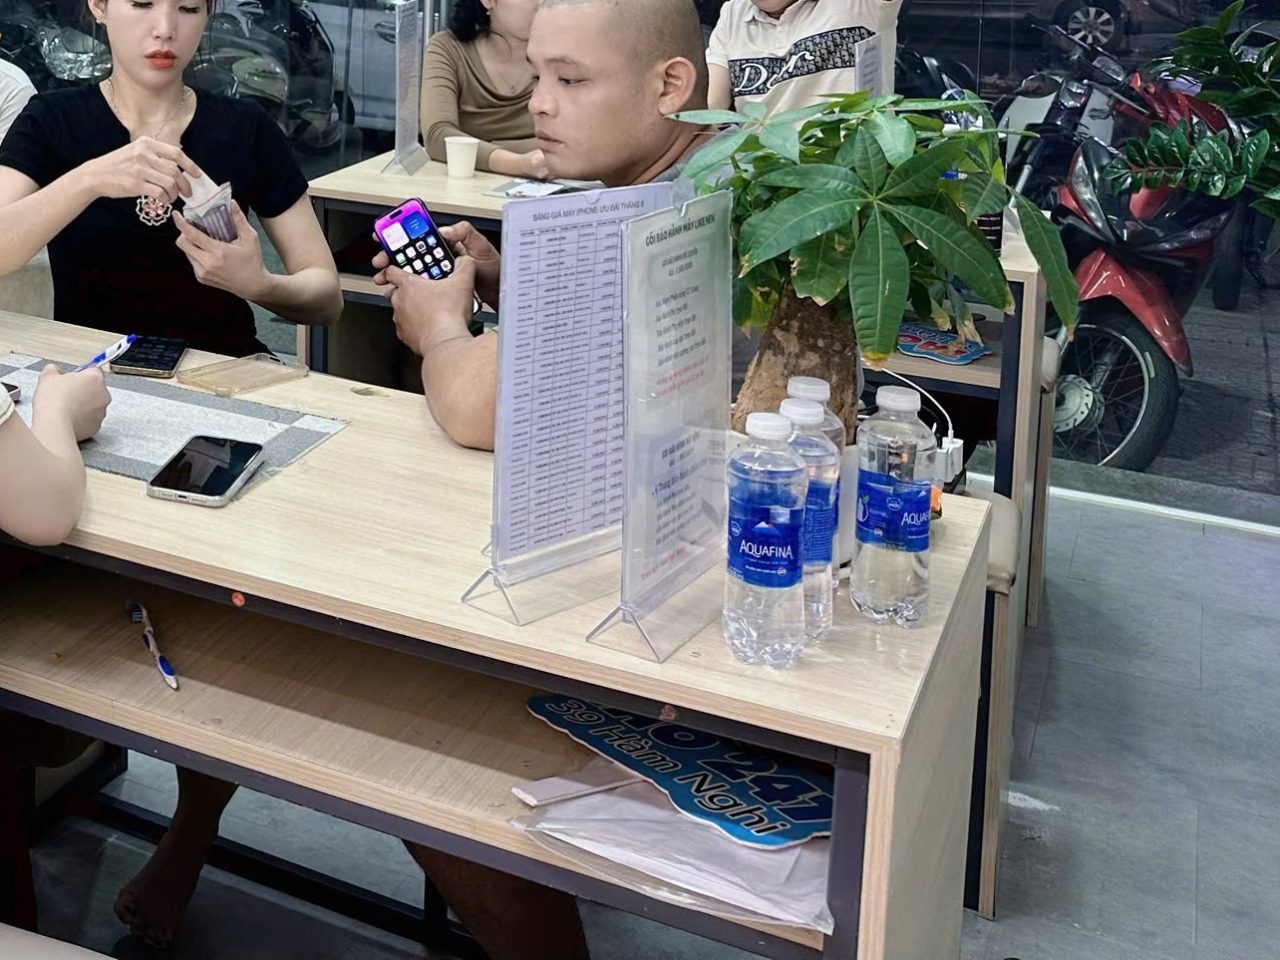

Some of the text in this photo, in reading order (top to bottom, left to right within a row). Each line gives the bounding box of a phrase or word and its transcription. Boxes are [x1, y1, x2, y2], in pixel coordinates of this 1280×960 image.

[739, 539, 795, 560] AQUAFINA
[544, 697, 792, 837] 39 Hàm Nghi
